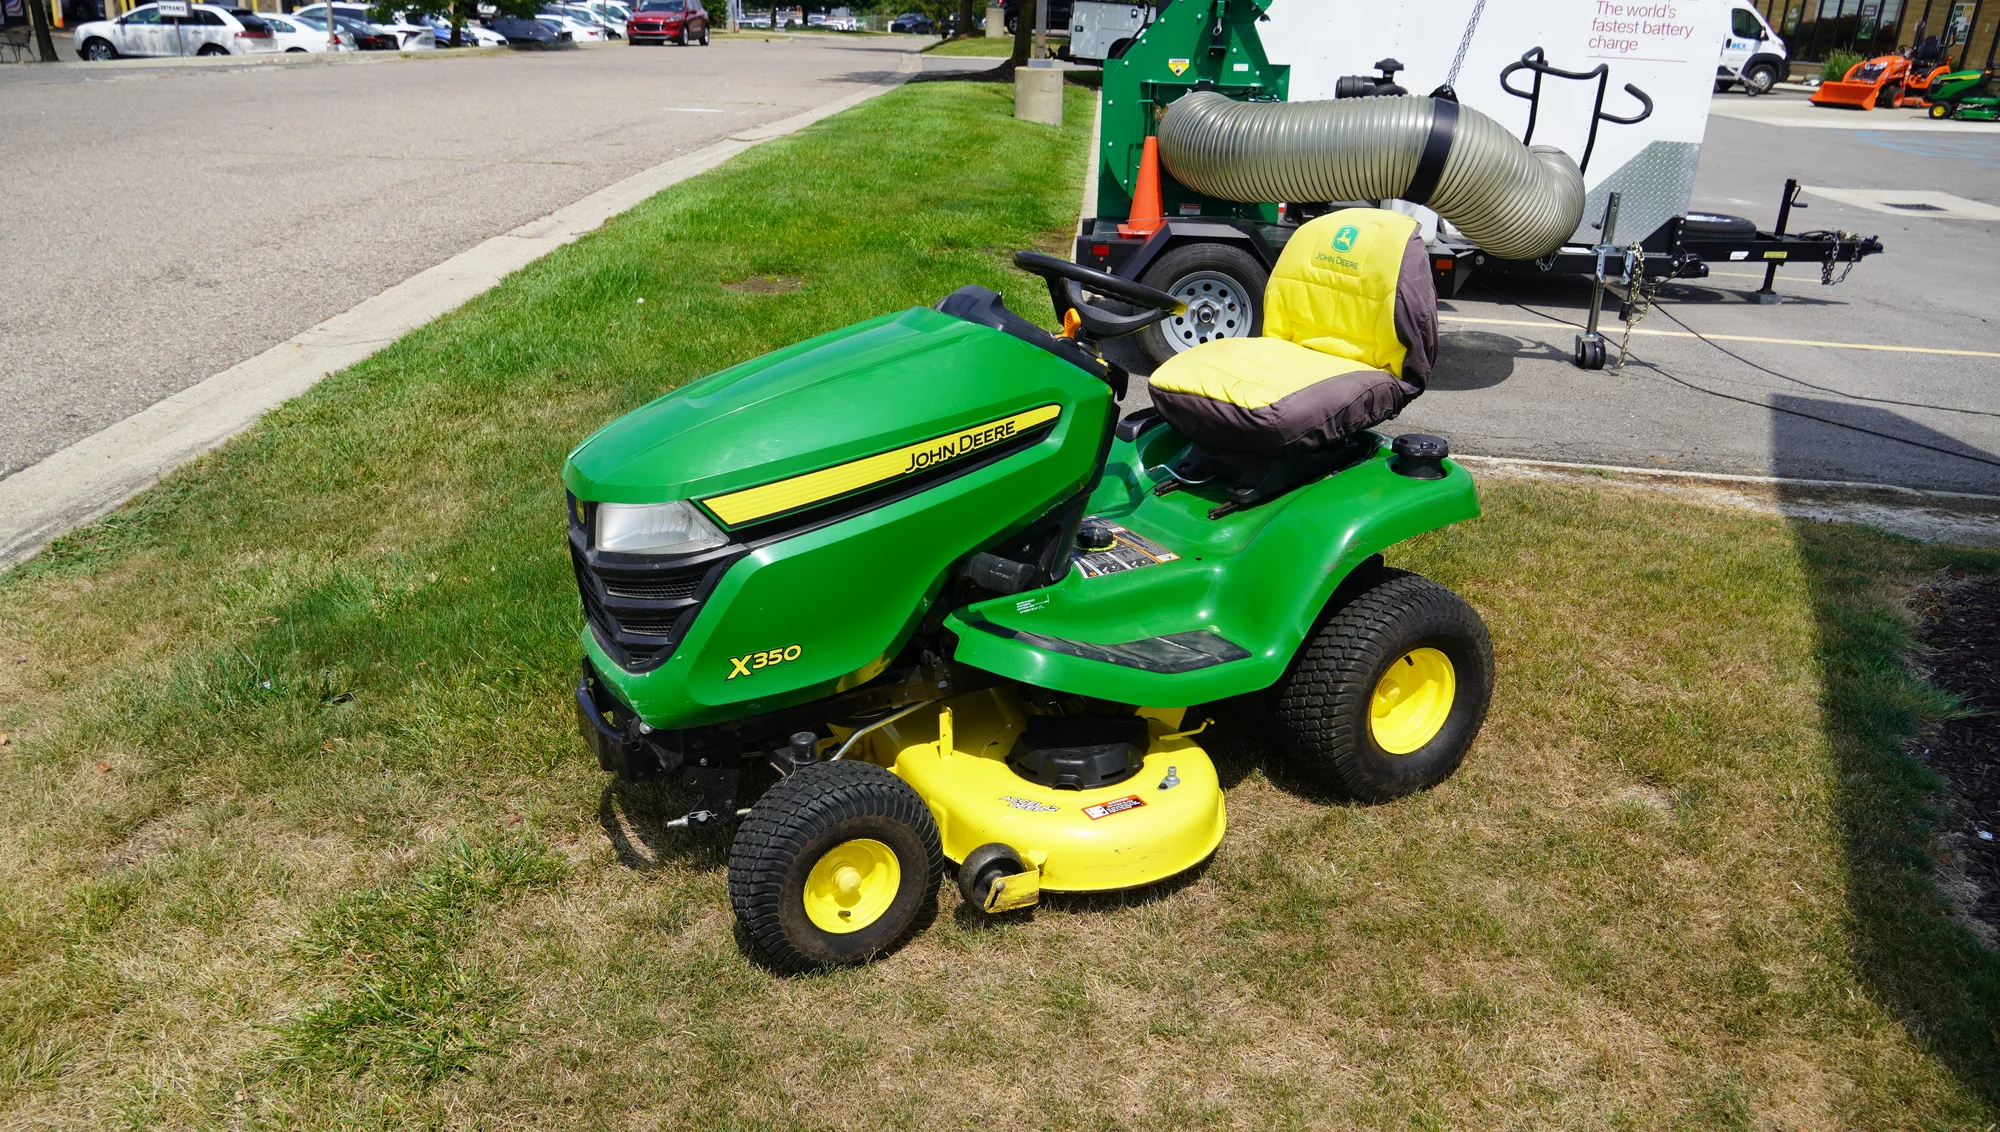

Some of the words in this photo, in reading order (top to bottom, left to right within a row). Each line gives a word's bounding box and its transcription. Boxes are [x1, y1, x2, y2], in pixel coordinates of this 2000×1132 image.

[1596, 1, 1623, 16] The
[1626, 4, 1676, 19] world's
[1592, 17, 1639, 34] fastest
[1642, 20, 1694, 39] battery
[1588, 35, 1638, 53] charge
[1315, 252, 1335, 263] JOHN
[1335, 256, 1359, 270] DEERE
[905, 442, 954, 472] JOHN
[959, 420, 1016, 453] DEERE
[726, 644, 803, 681] X350
